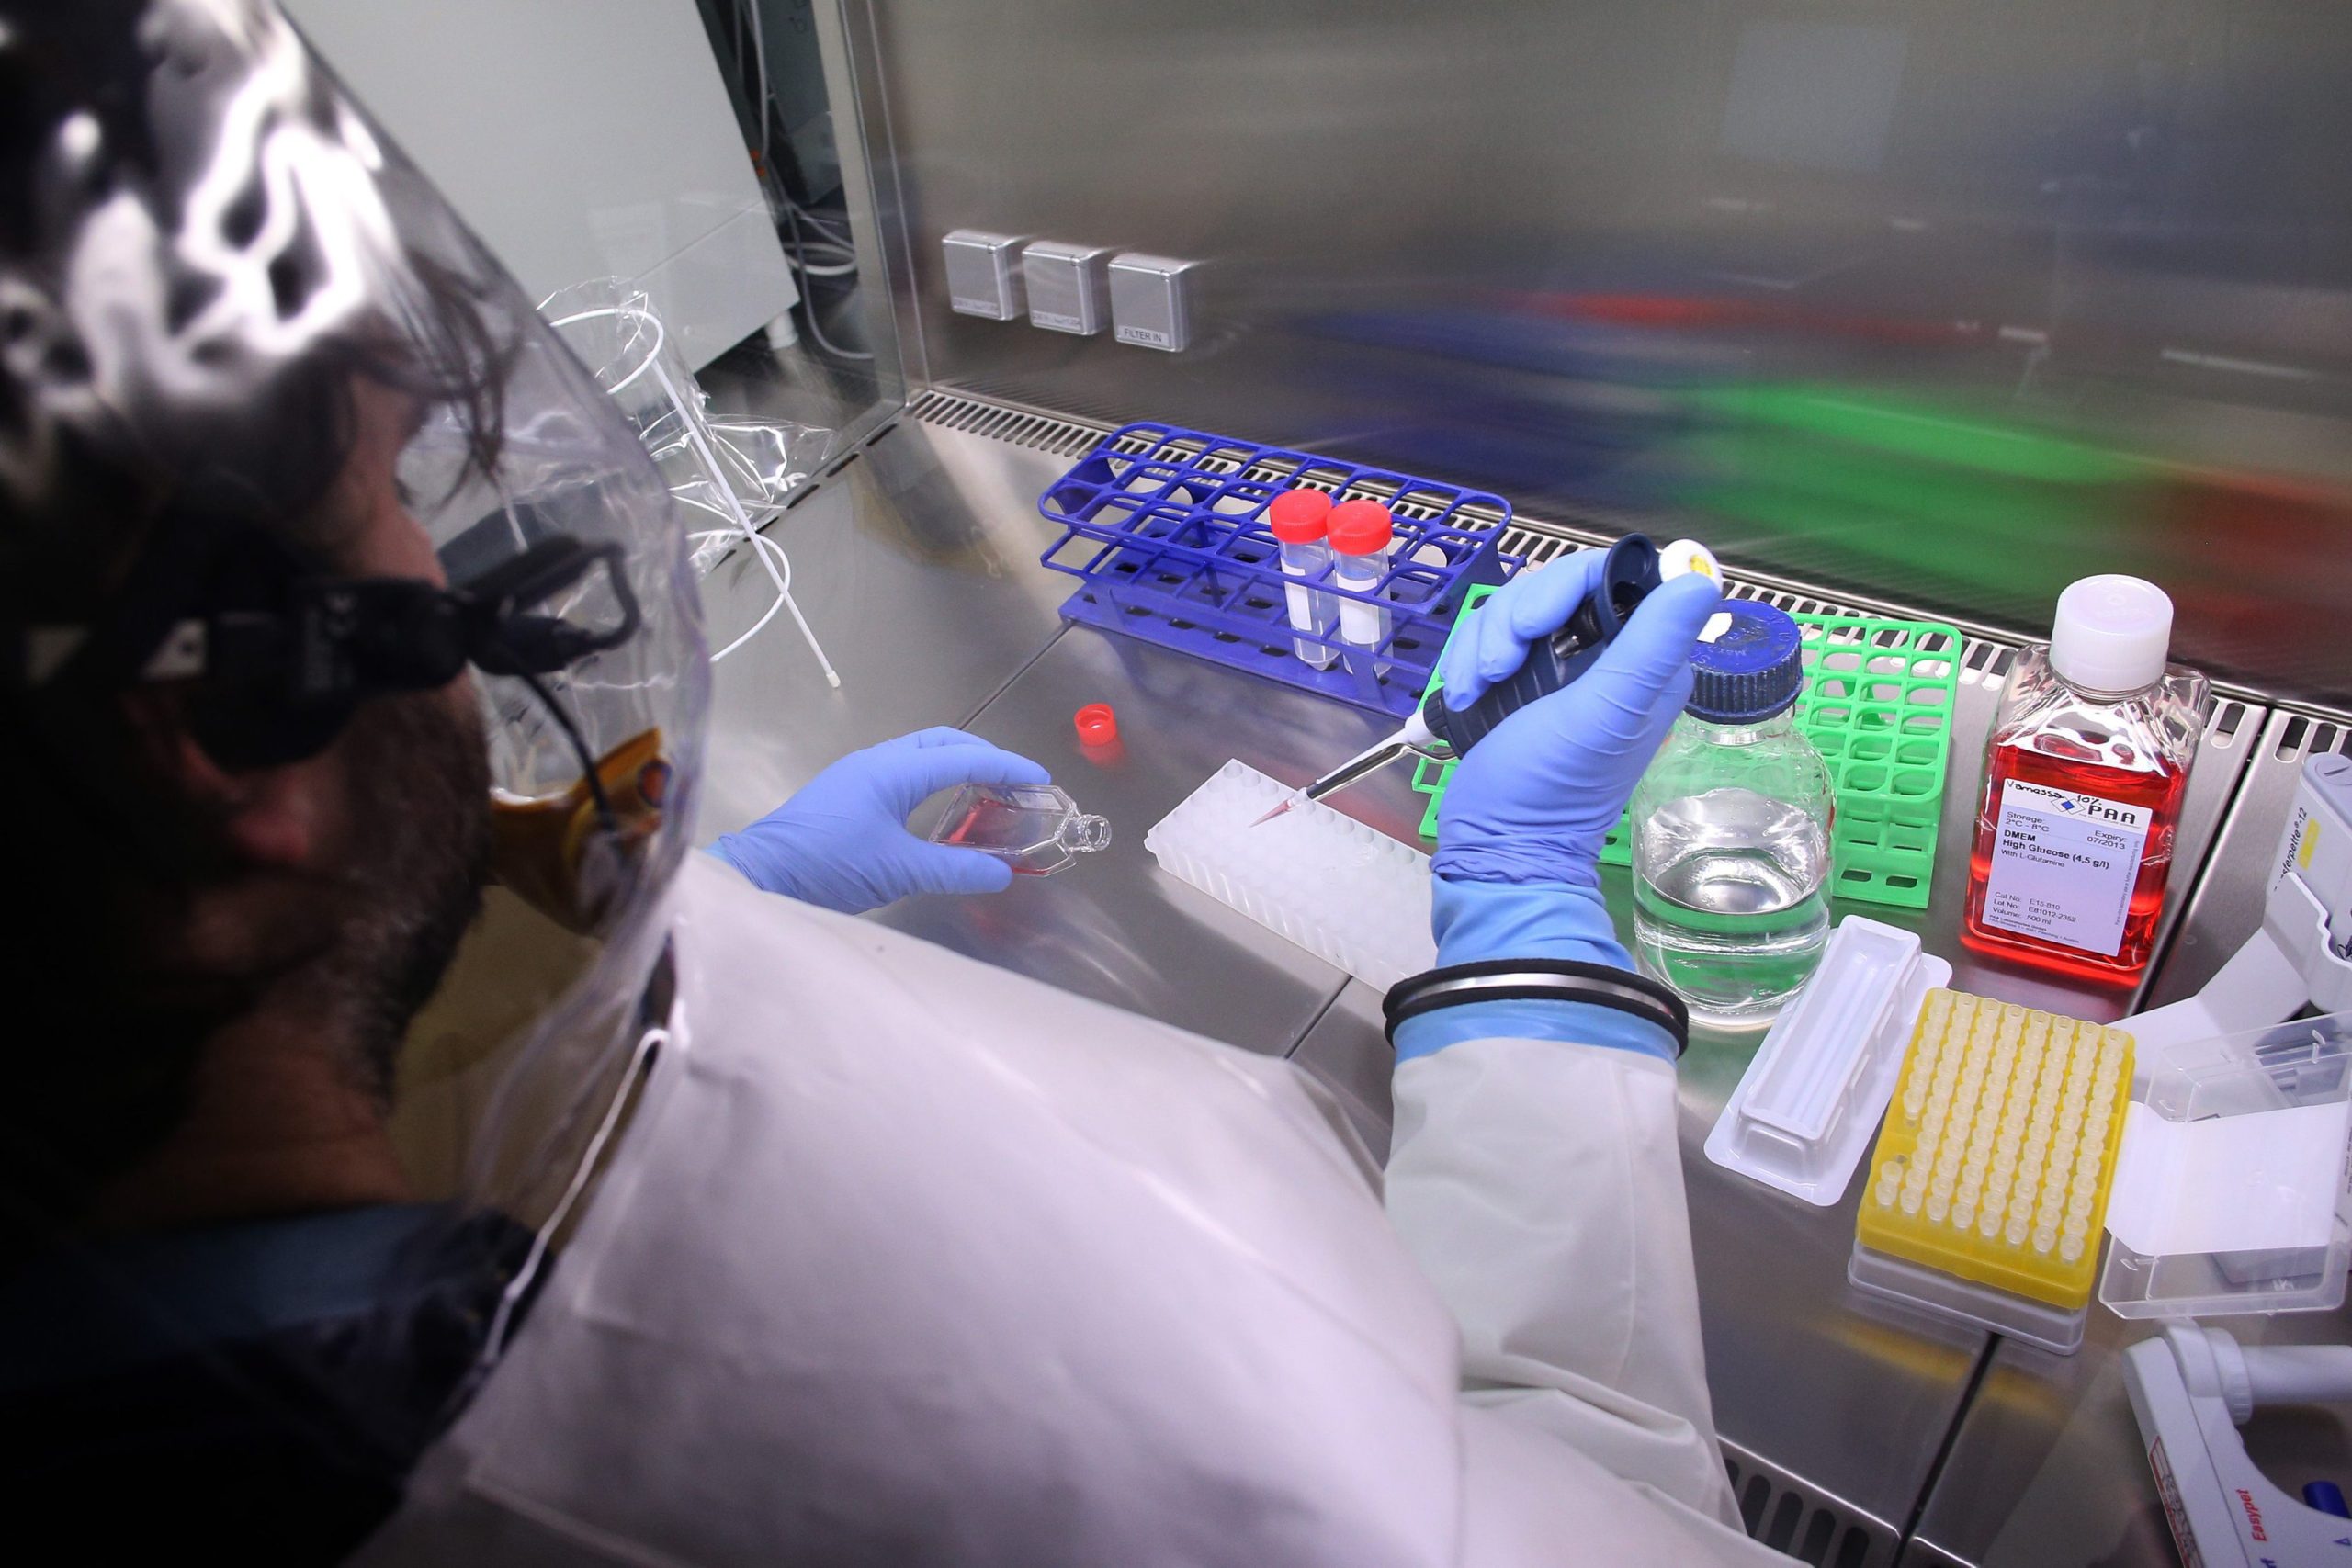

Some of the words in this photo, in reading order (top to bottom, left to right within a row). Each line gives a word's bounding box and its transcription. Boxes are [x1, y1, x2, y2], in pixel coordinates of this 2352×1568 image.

[1124, 327, 1152, 341] FILTER
[1153, 331, 1162, 343] IN
[2087, 804, 2136, 825] PAA
[2004, 829, 2036, 842] DMEM
[2095, 829, 2127, 843] Expiry:
[2086, 836, 2126, 851] 07/2013
[2001, 848, 2018, 858] With
[2019, 851, 2065, 868] L-Glutamine
[2002, 839, 2026, 852] High
[2029, 844, 2070, 860] Glucose
[2072, 853, 2091, 866] (4,5
[2092, 857, 2110, 870] g/l)
[1994, 898, 2005, 908] Lot
[2027, 914, 2041, 922] 500
[2235, 1488, 2267, 1542] Easypet
